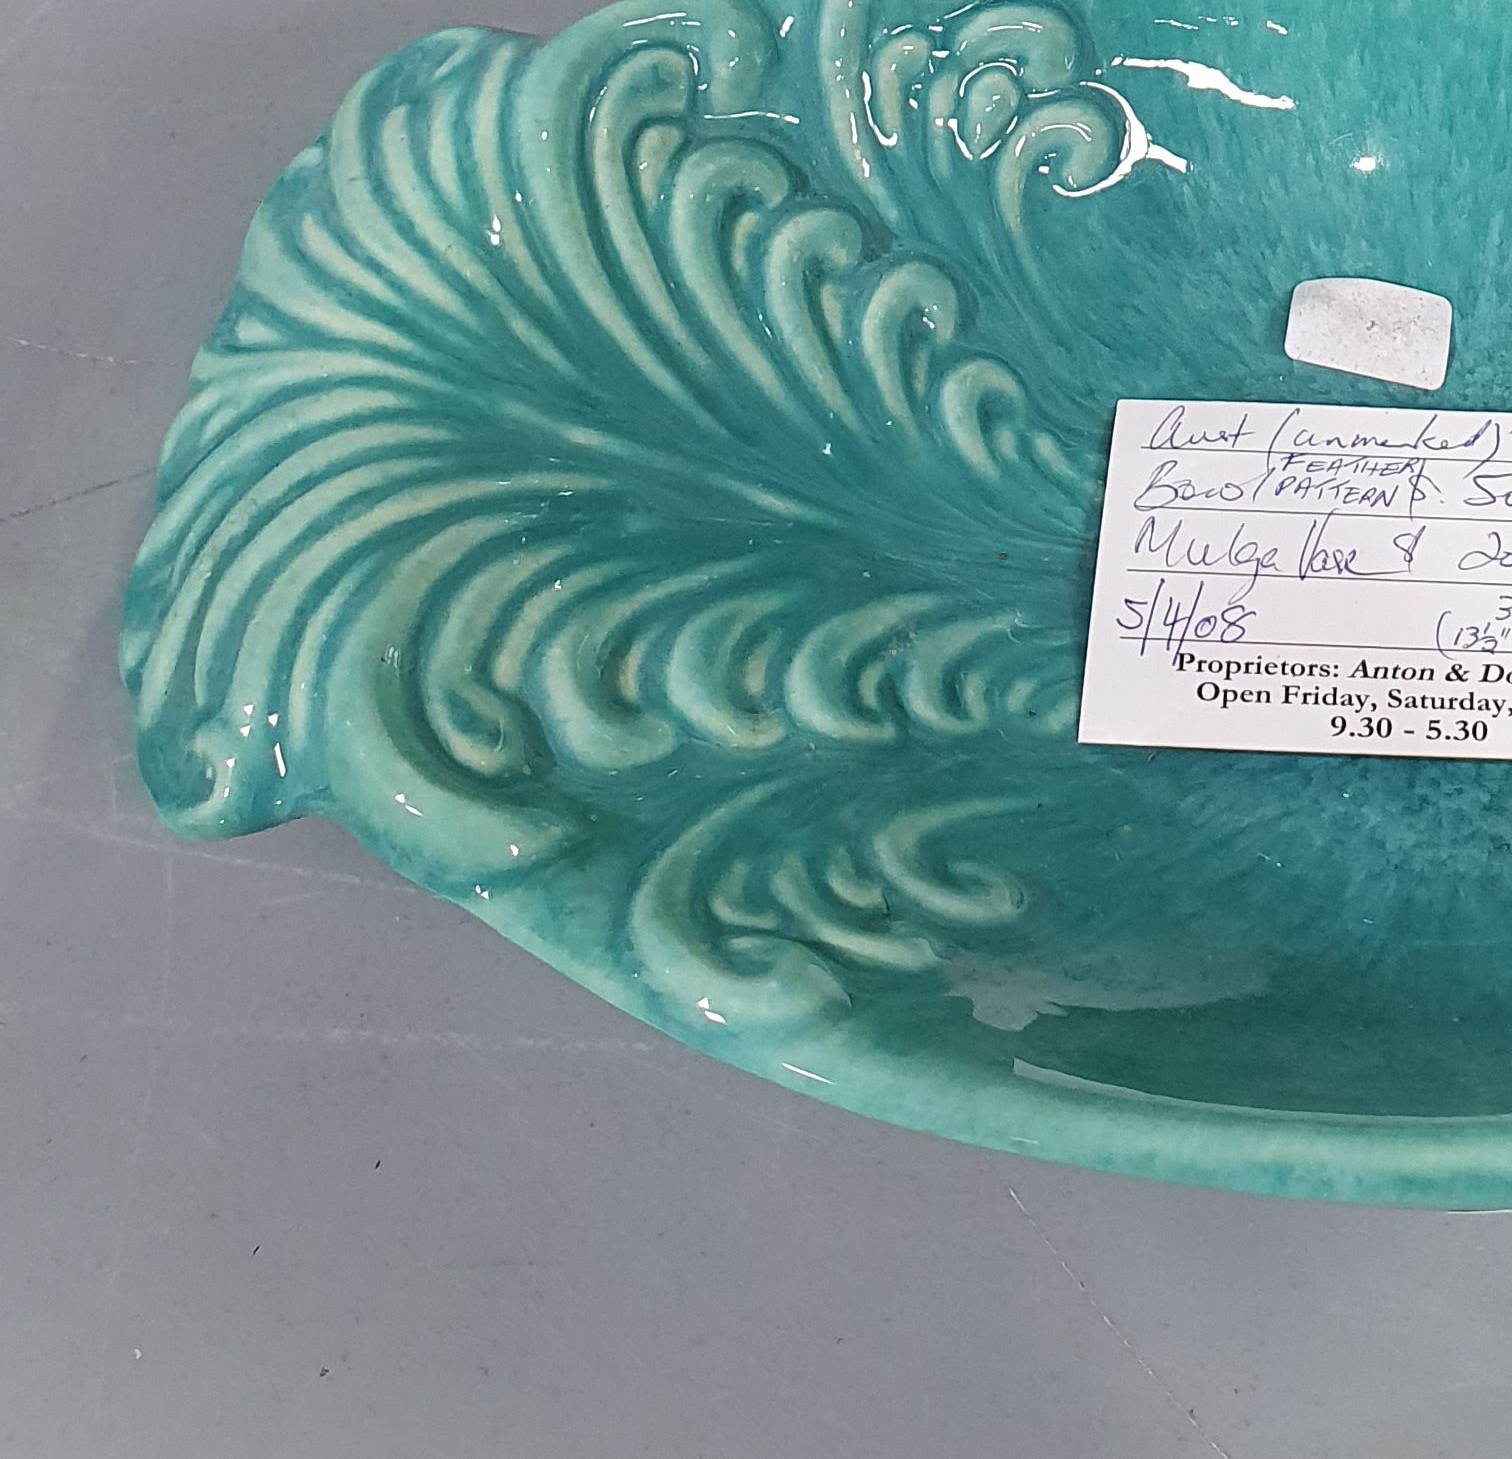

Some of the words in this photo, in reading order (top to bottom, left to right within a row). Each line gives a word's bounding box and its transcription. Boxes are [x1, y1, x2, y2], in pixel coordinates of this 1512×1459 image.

[1280, 452, 1417, 477] FEATHER
[1274, 474, 1400, 509] PATTERN
[1115, 577, 1258, 667] 5/4/08
[1175, 652, 1340, 681] Proprietors:
[1349, 658, 1434, 686] Anton
[1444, 663, 1470, 683] &
[1196, 681, 1272, 709] Open
[1280, 685, 1378, 714] Friday,
[1330, 715, 1393, 740] 9.30
[1425, 719, 1489, 743] 5.30
